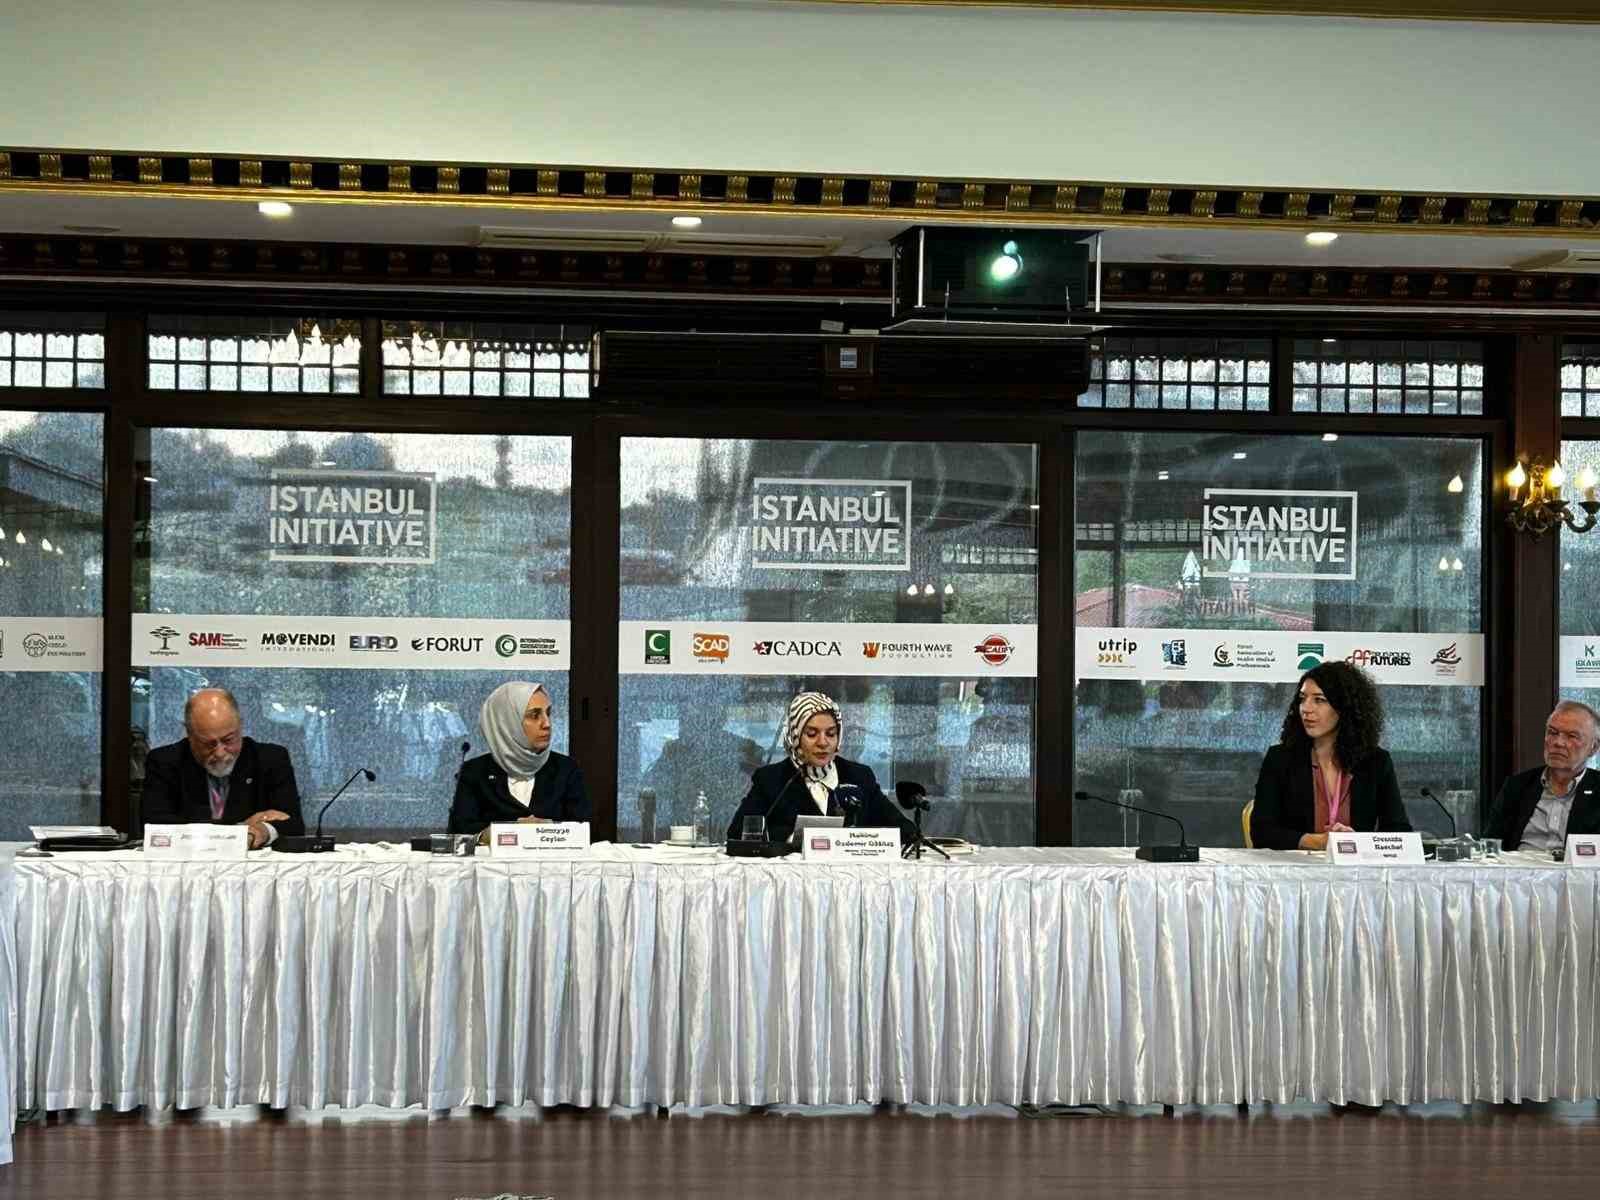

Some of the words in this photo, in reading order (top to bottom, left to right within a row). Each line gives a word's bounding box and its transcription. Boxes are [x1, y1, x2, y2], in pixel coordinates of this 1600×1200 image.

[270, 485, 424, 515] ISTANBUL
[752, 494, 900, 523] ISTANBUL
[1203, 504, 1346, 532] ISTANBUL
[270, 517, 424, 546] INITIATIVE
[752, 526, 900, 554] INITIATIVE
[1203, 535, 1346, 563] INITIATIVE
[188, 632, 221, 646] SAM
[261, 633, 336, 646] MOVENDI
[426, 637, 484, 652] FORUT
[694, 637, 729, 652] SCAD
[1098, 637, 1137, 655] utrip
[773, 641, 842, 656] CADCA
[881, 643, 922, 652] FOURTH
[924, 643, 953, 652] WAVE
[1370, 656, 1411, 666] FUTURES
